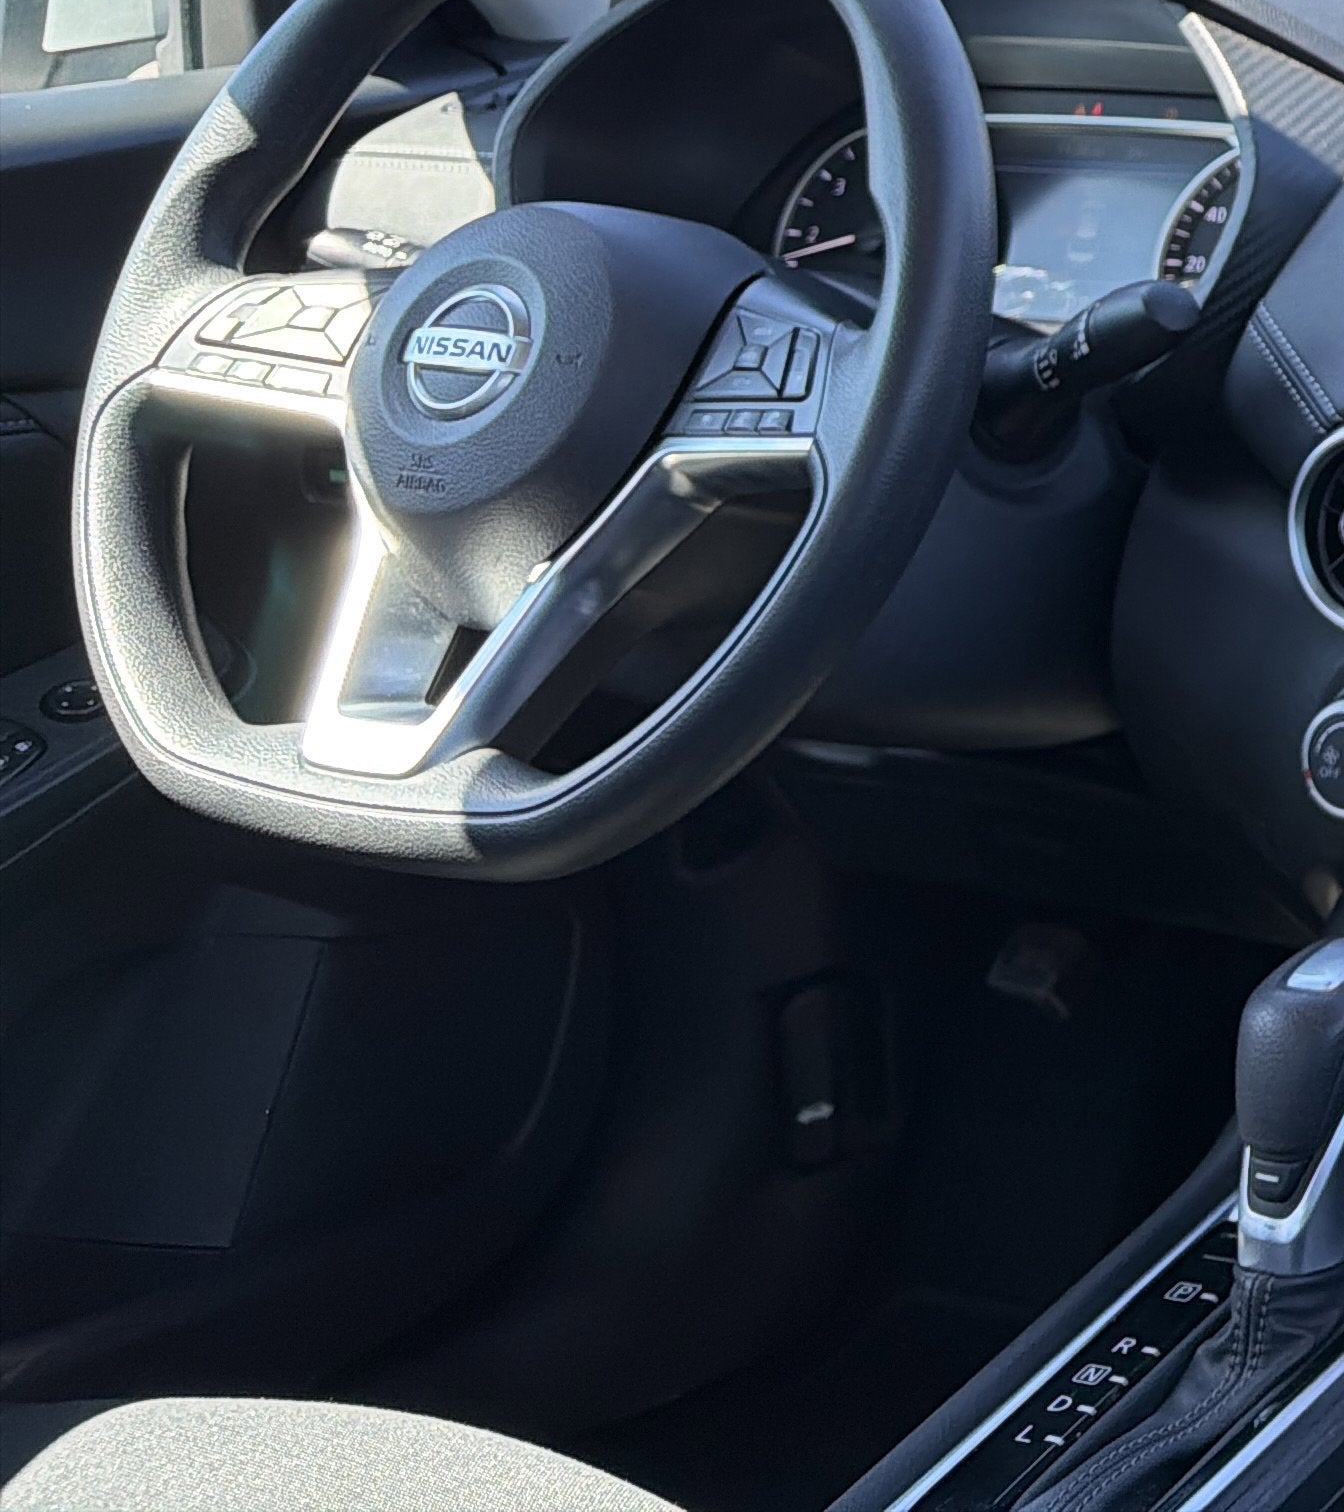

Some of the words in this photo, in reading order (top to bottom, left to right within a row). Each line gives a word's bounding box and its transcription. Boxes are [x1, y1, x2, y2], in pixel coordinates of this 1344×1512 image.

[1204, 206, 1227, 223] 40
[1184, 255, 1206, 273] 20
[411, 335, 512, 363] NISSAN
[1320, 767, 1339, 779] OFF
[1111, 1336, 1137, 1355] R
[1047, 1395, 1072, 1411] D
[1014, 1424, 1034, 1444] L
